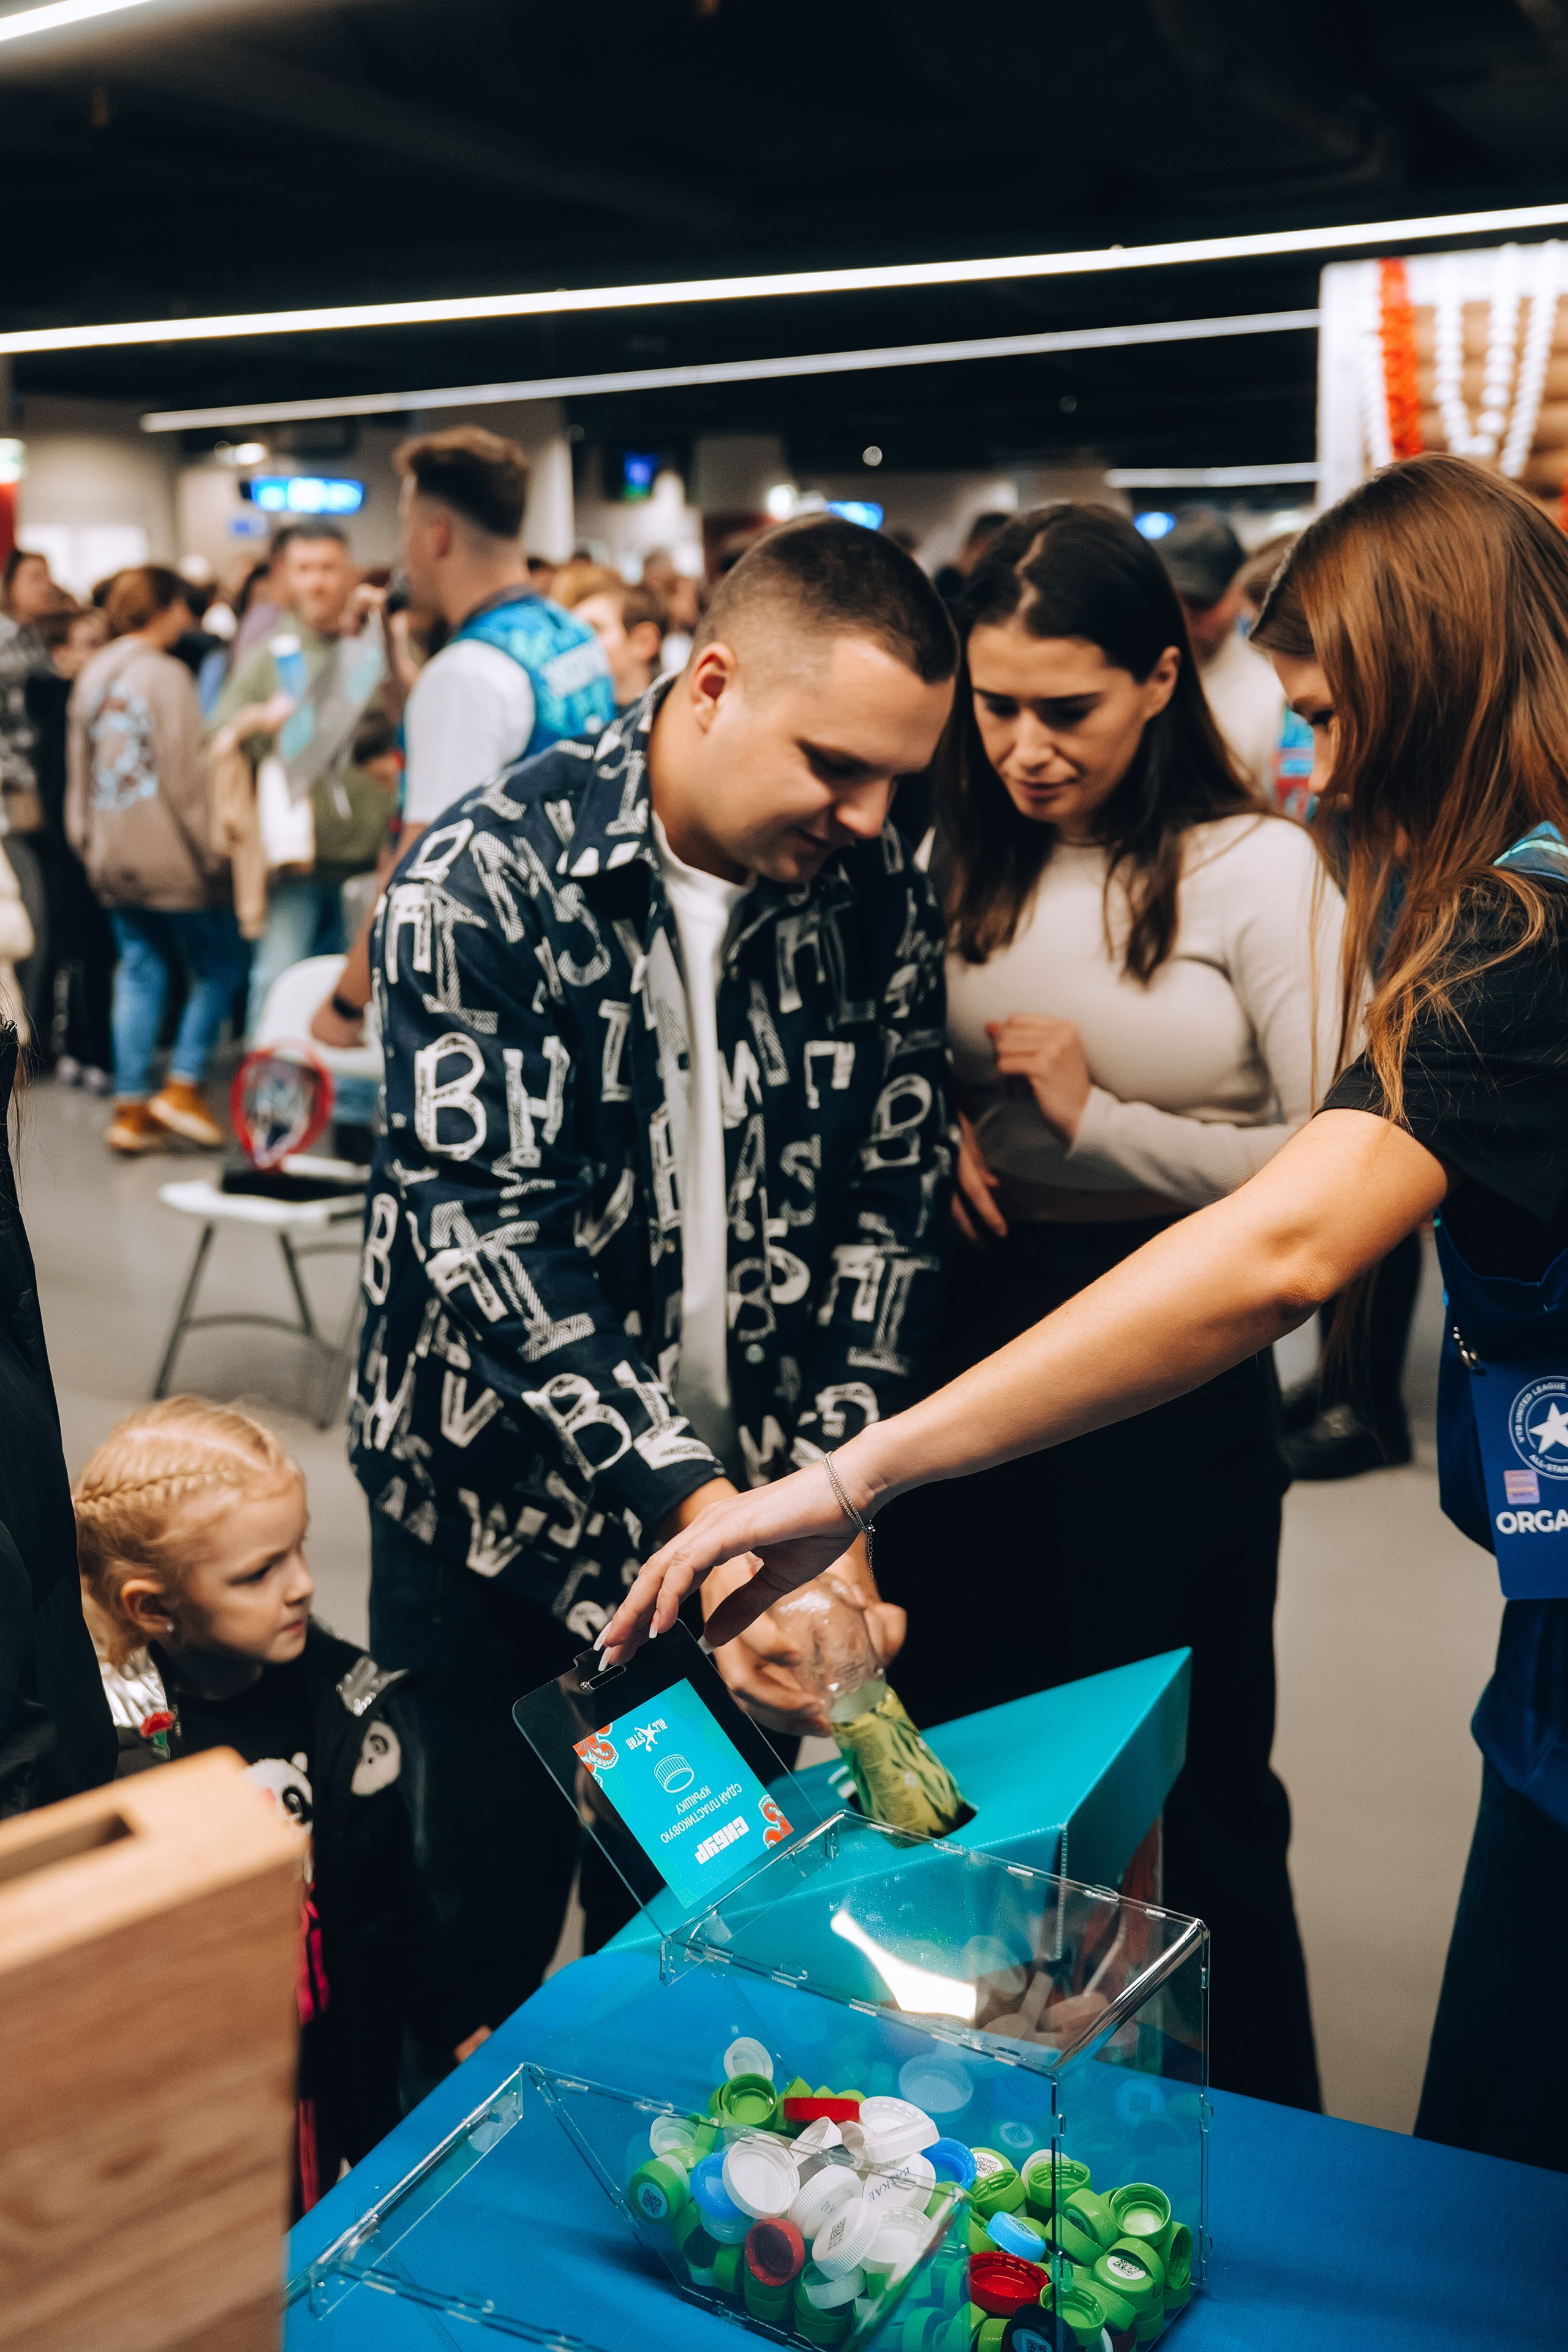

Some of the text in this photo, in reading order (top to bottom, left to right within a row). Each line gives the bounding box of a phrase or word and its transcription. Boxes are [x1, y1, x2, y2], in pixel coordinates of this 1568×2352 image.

[660, 1783, 742, 1844] СДАЙ ПЛАСТИКОВУЮ
[676, 1785, 711, 1815] КРЫШКУ
[694, 1815, 750, 1865] СИБУР
